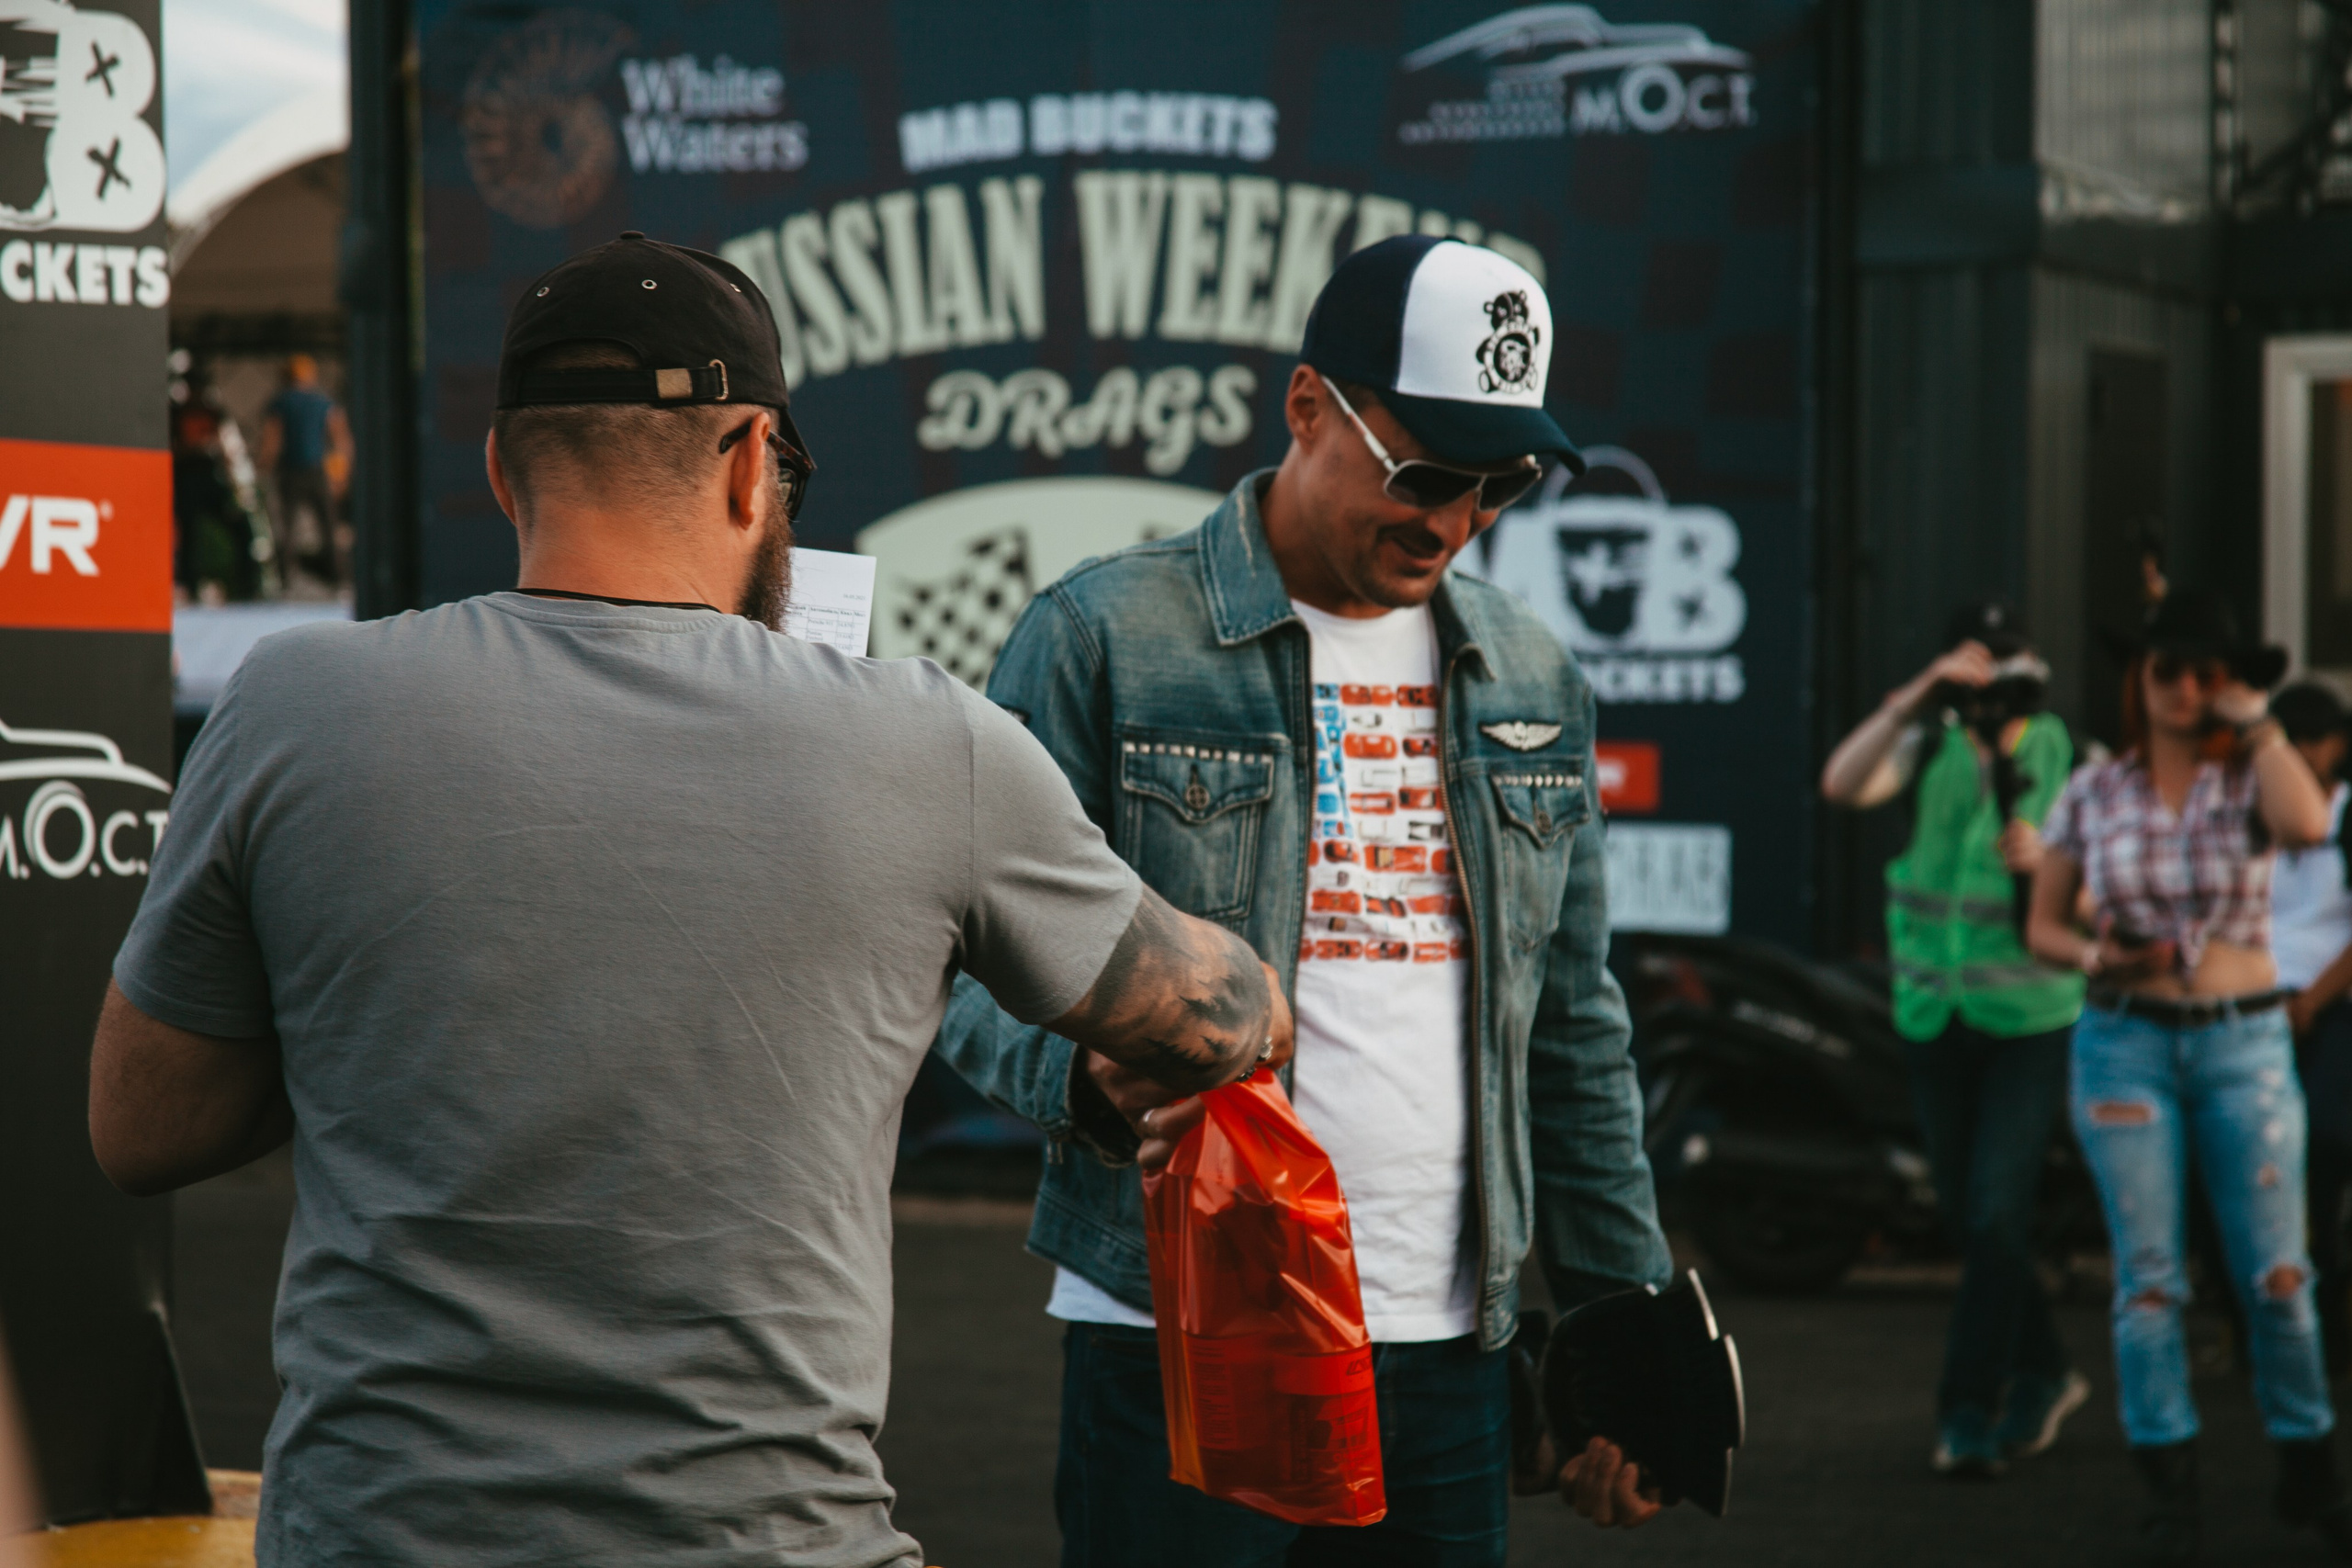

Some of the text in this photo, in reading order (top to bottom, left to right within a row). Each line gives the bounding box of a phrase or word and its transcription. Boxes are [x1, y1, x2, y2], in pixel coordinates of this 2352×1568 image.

[622, 53, 786, 117] White
[622, 112, 809, 175] Waters
[899, 90, 1279, 174] MAD BUCKETS
[0, 238, 171, 309] CKETS
[717, 175, 1046, 394] USSIAN
[917, 365, 1257, 477] DRAGS
[1575, 656, 1745, 704] CKETS
